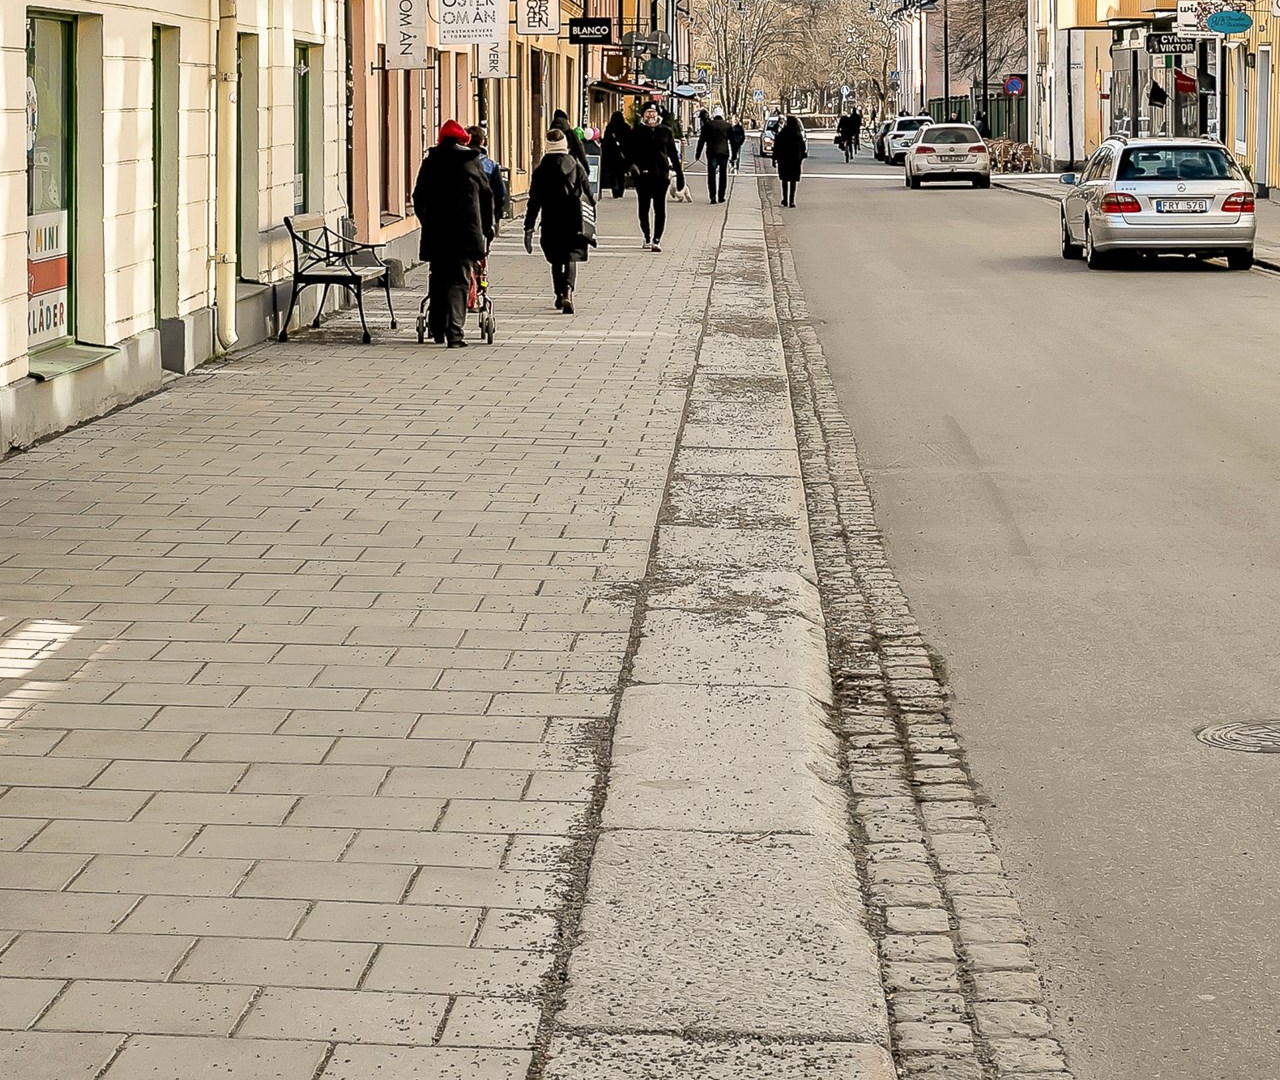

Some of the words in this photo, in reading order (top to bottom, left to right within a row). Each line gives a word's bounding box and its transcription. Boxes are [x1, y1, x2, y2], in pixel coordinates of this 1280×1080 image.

[399, 0, 413, 27] OM
[442, 11, 470, 24] OM
[472, 7, 496, 24] ÅN
[572, 26, 609, 35] BLANCO
[399, 31, 417, 56] ÅN
[1160, 43, 1194, 52] VIKTOR
[1162, 201, 1180, 209] FRY
[1186, 201, 1204, 209] 576
[35, 225, 59, 253] MINI
